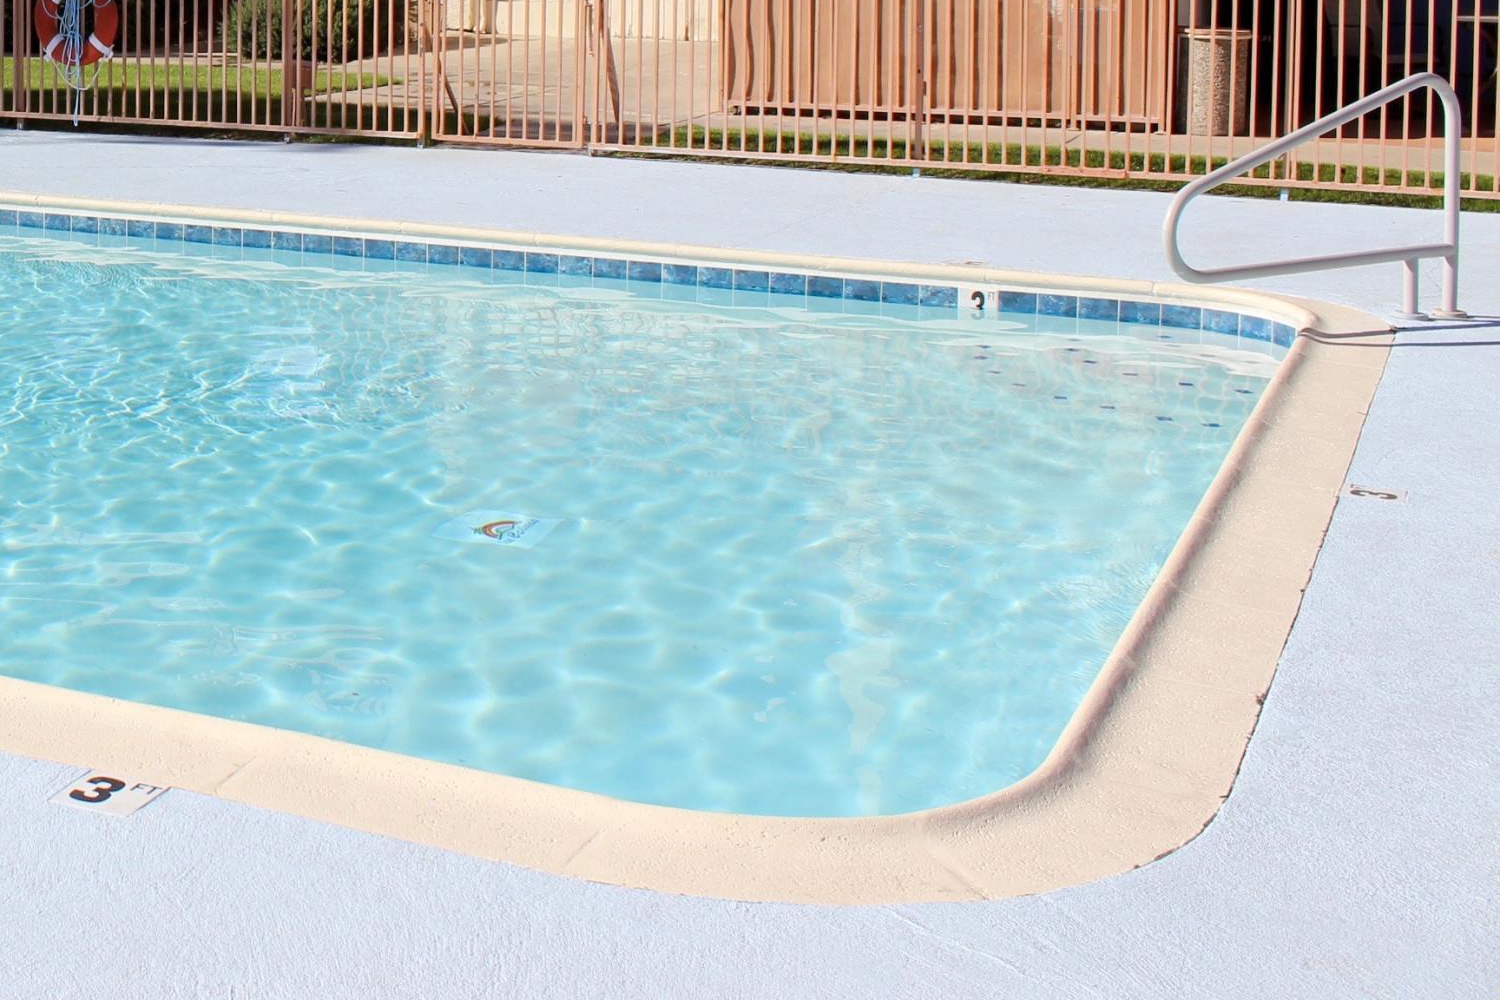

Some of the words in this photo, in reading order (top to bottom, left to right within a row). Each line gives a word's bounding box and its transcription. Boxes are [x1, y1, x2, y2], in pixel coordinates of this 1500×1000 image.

[1350, 489, 1398, 500] 3
[68, 775, 127, 803] 3
[130, 782, 163, 795] FT
